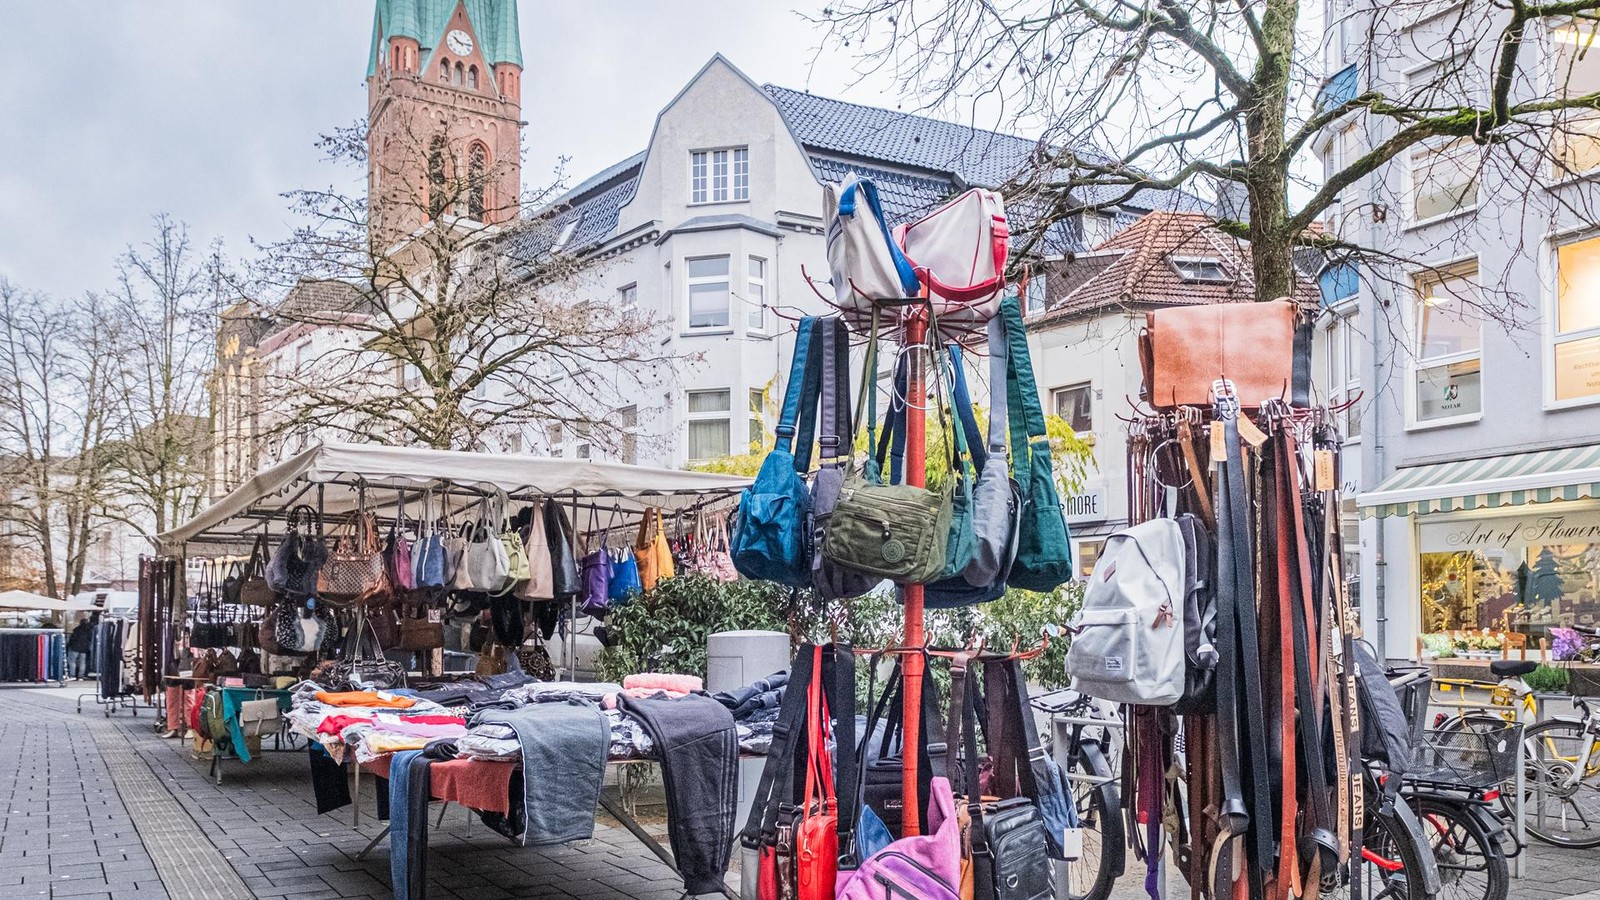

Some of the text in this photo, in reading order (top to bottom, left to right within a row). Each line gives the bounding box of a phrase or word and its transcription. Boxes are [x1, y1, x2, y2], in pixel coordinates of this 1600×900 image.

[1066, 494, 1098, 516] MORE
[1446, 522, 1494, 546] Art
[1496, 521, 1523, 549] of
[1347, 677, 1358, 729] JEANS
[1352, 773, 1363, 829] JEANS
